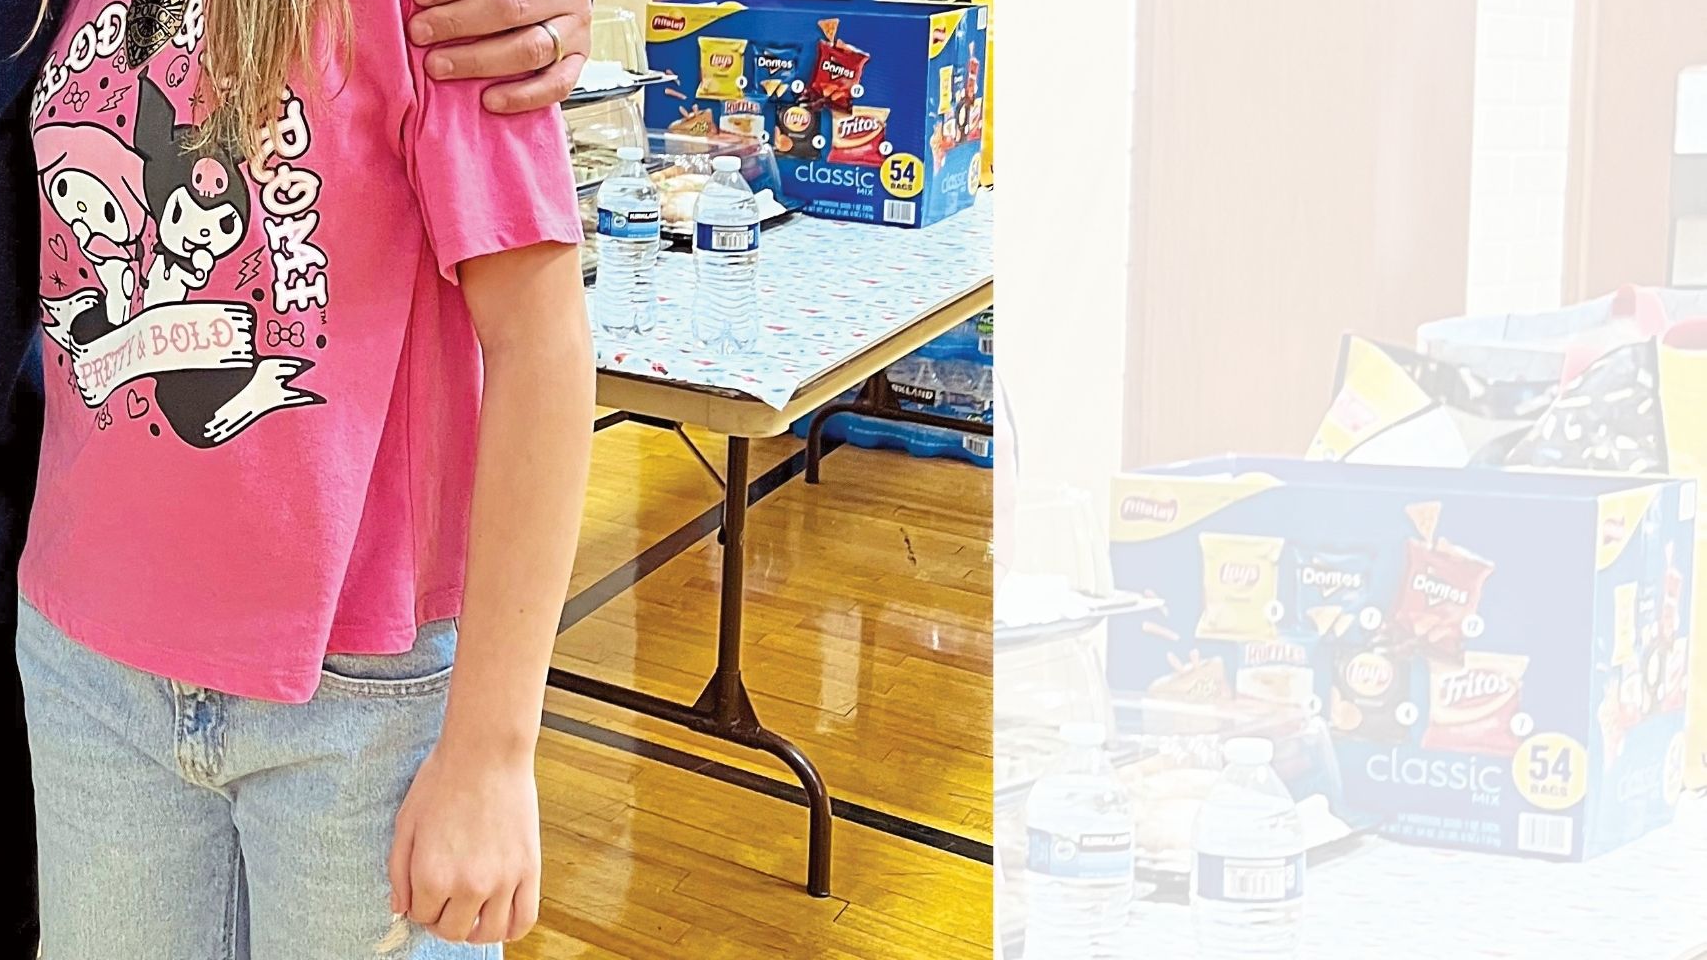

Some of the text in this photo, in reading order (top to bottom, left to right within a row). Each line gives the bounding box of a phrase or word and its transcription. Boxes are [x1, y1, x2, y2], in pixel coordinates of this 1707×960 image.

[758, 56, 793, 70] Doritos
[822, 61, 854, 79] Doritos
[840, 116, 880, 138] Fritos
[795, 162, 875, 188] classic
[890, 160, 916, 182] 54
[857, 187, 873, 196] MIX
[890, 183, 913, 191] BAGS
[79, 318, 234, 389] PRETTY & BOLD
[1302, 567, 1362, 589] Doritos
[1412, 574, 1469, 605] Doritos
[1439, 669, 1510, 706] Fritos
[1365, 749, 1502, 794] classic
[1528, 744, 1572, 784] 54
[1471, 791, 1501, 807] MIX
